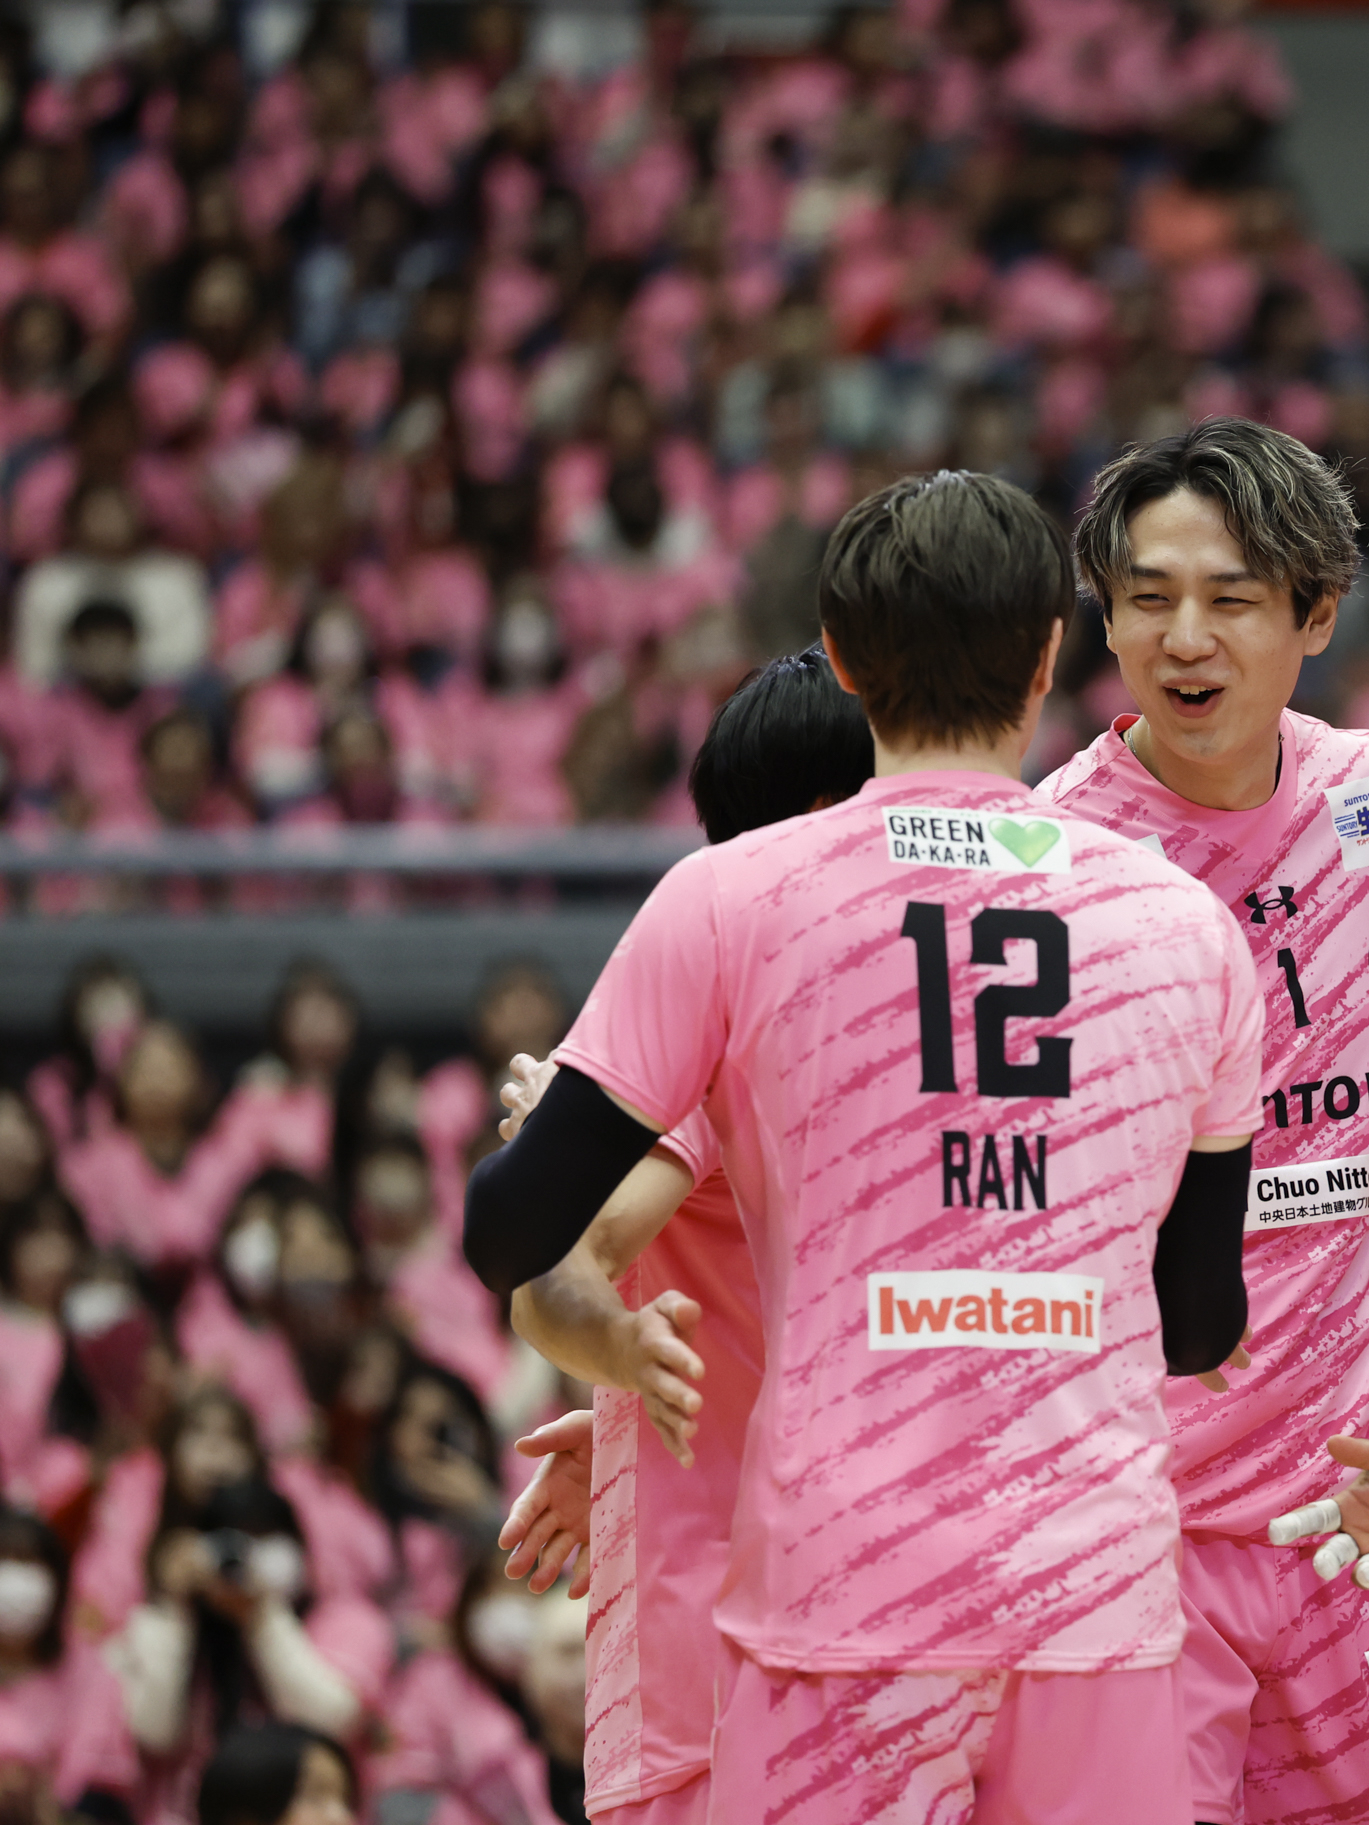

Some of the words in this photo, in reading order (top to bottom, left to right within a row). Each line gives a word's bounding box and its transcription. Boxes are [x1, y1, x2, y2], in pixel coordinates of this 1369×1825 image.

[889, 815, 985, 844] GREEN
[901, 901, 1073, 1099] 12
[1277, 948, 1311, 1029] 1
[941, 1131, 1047, 1212] RAN
[1257, 1176, 1320, 1202] Chuo
[878, 1286, 1095, 1339] Iwatani
